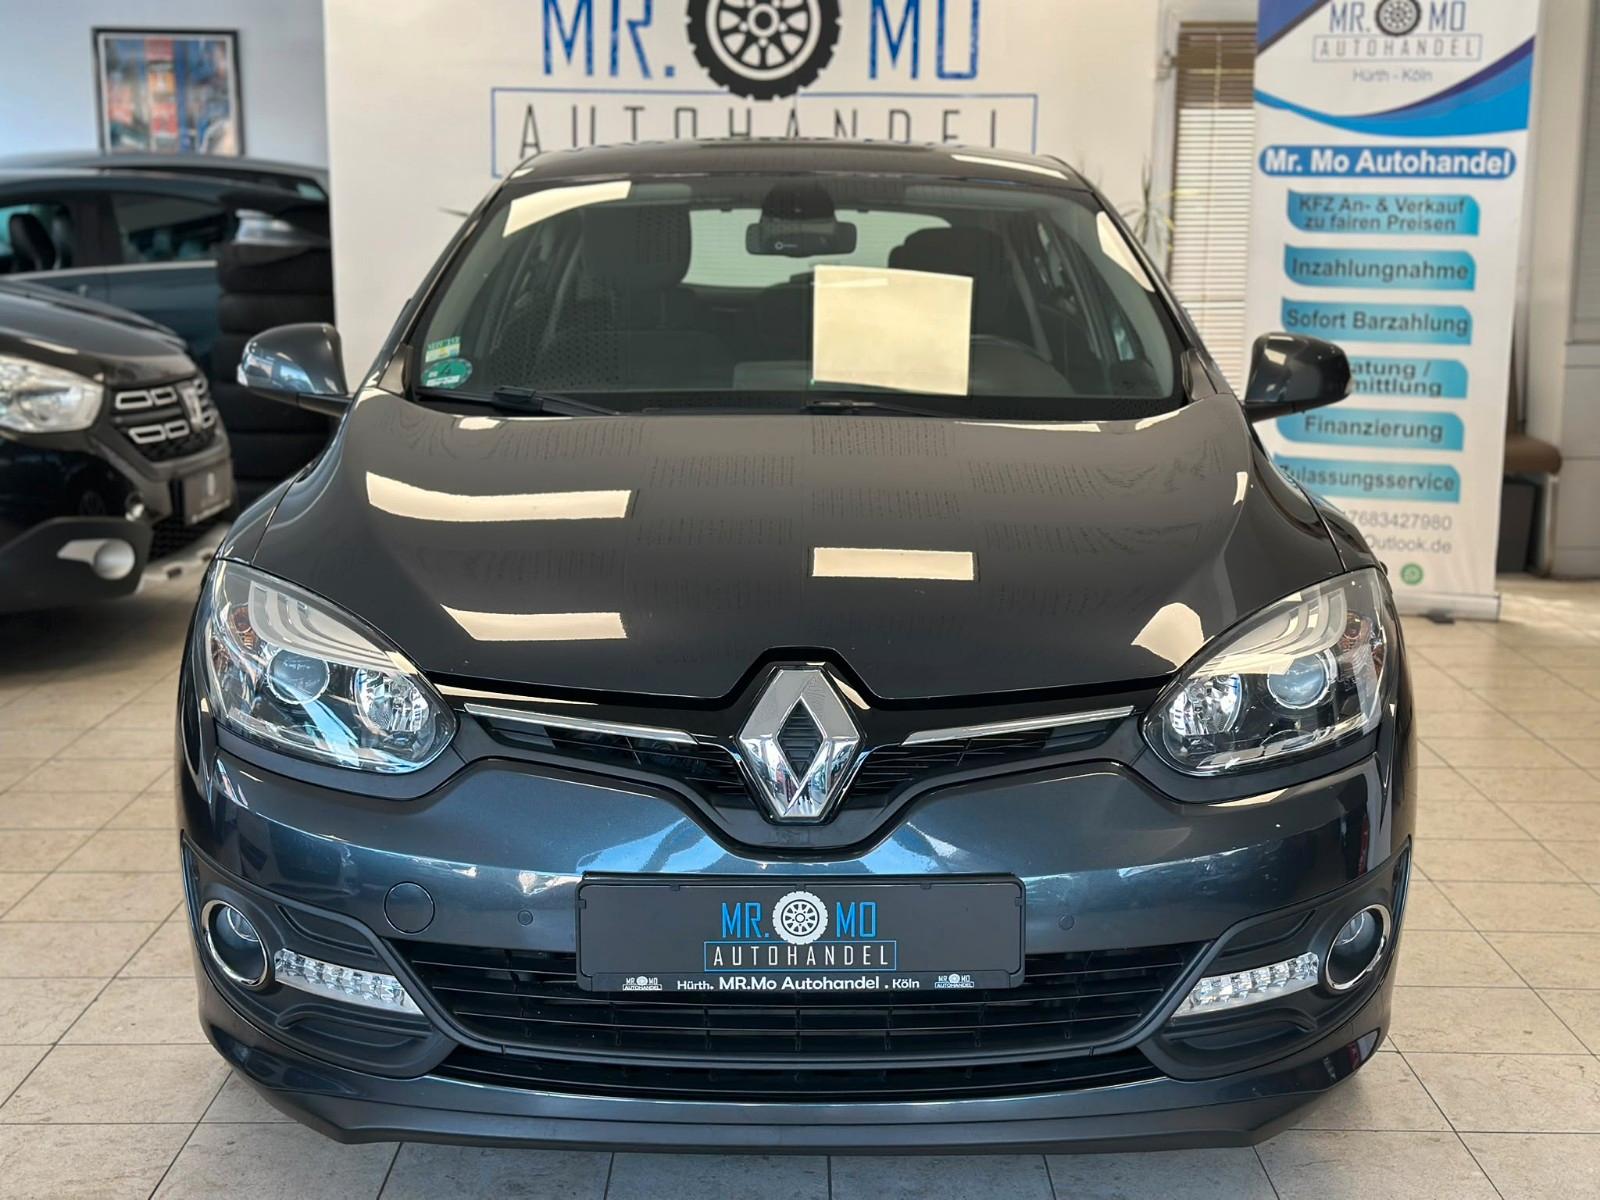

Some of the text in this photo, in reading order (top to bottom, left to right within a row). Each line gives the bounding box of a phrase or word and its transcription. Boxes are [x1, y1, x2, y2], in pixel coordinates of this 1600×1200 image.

[1329, 1, 1467, 33] MR. MO
[543, 0, 980, 80] MR. MO
[1320, 38, 1474, 57] AUTOHANDEL
[1352, 68, 1390, 82] Hürth
[1402, 69, 1433, 82] Köln
[1264, 150, 1511, 175] Mr. Mo Autohandel
[1299, 198, 1466, 214] KFZ An- & Verkauf
[1304, 215, 1456, 231] zu fairen Preisen
[1291, 258, 1469, 282] Inzahlungnahme
[1287, 309, 1469, 337] Sofort Barzahlung
[1350, 361, 1416, 379] atung
[1304, 415, 1444, 442] Finanzierung
[1347, 510, 1453, 532] 7683427980
[1366, 533, 1453, 554] Outlook.de
[721, 902, 877, 938] MR. MO
[713, 945, 889, 967] AUTOHANDEL
[719, 976, 777, 990] MR.Mo
[781, 976, 879, 990] Autohandel
[892, 978, 920, 989] Köln
